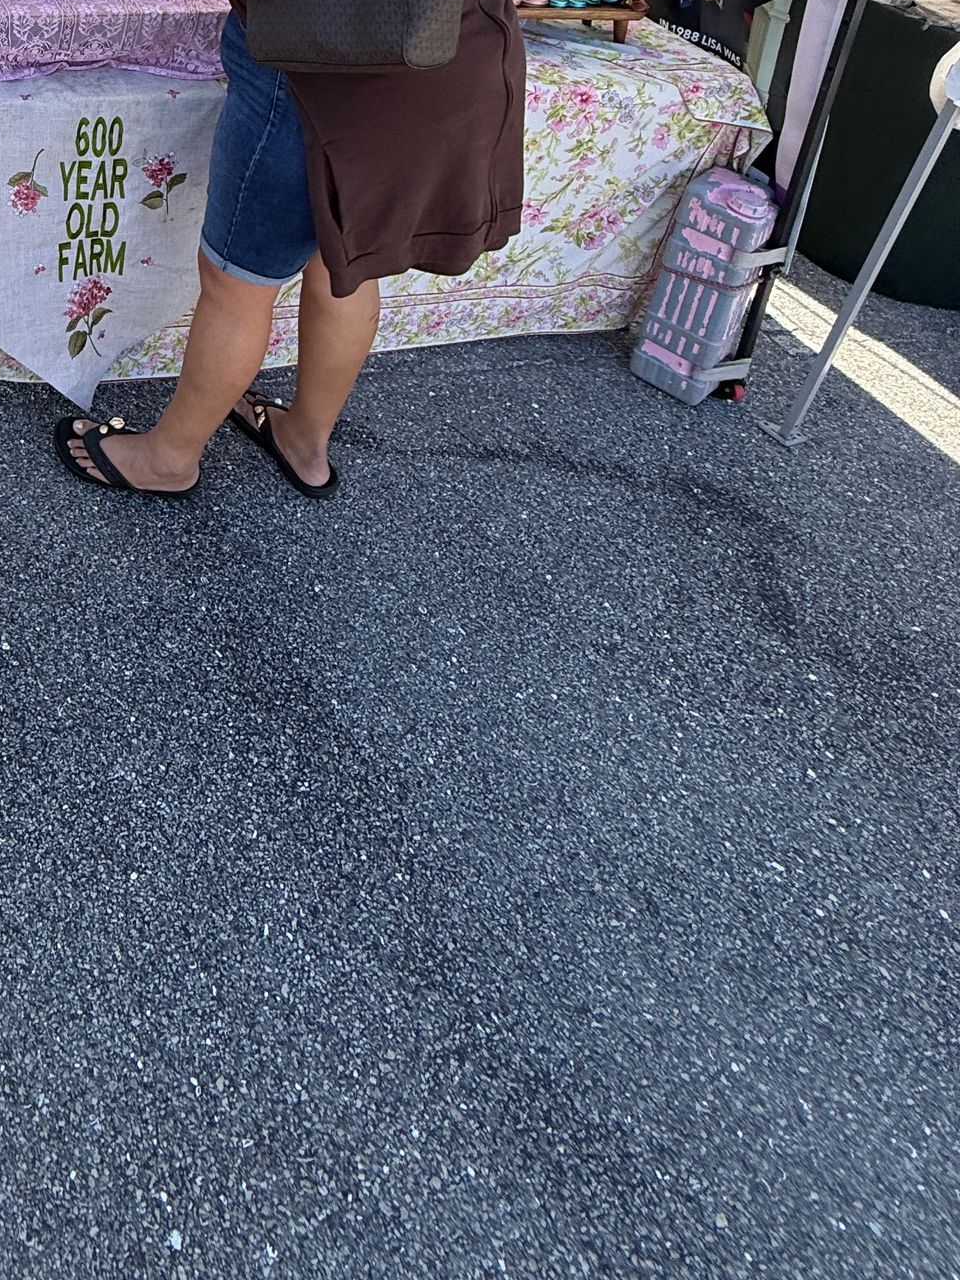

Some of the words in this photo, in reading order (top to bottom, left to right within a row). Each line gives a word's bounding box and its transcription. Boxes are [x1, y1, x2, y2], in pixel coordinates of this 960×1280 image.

[670, 23, 701, 42] 1988
[700, 35, 722, 53] LISA
[723, 46, 741, 67] WAS
[75, 116, 124, 157] 600
[60, 158, 128, 201] YEAR
[65, 202, 120, 240] OLD
[57, 237, 127, 283] FARM
